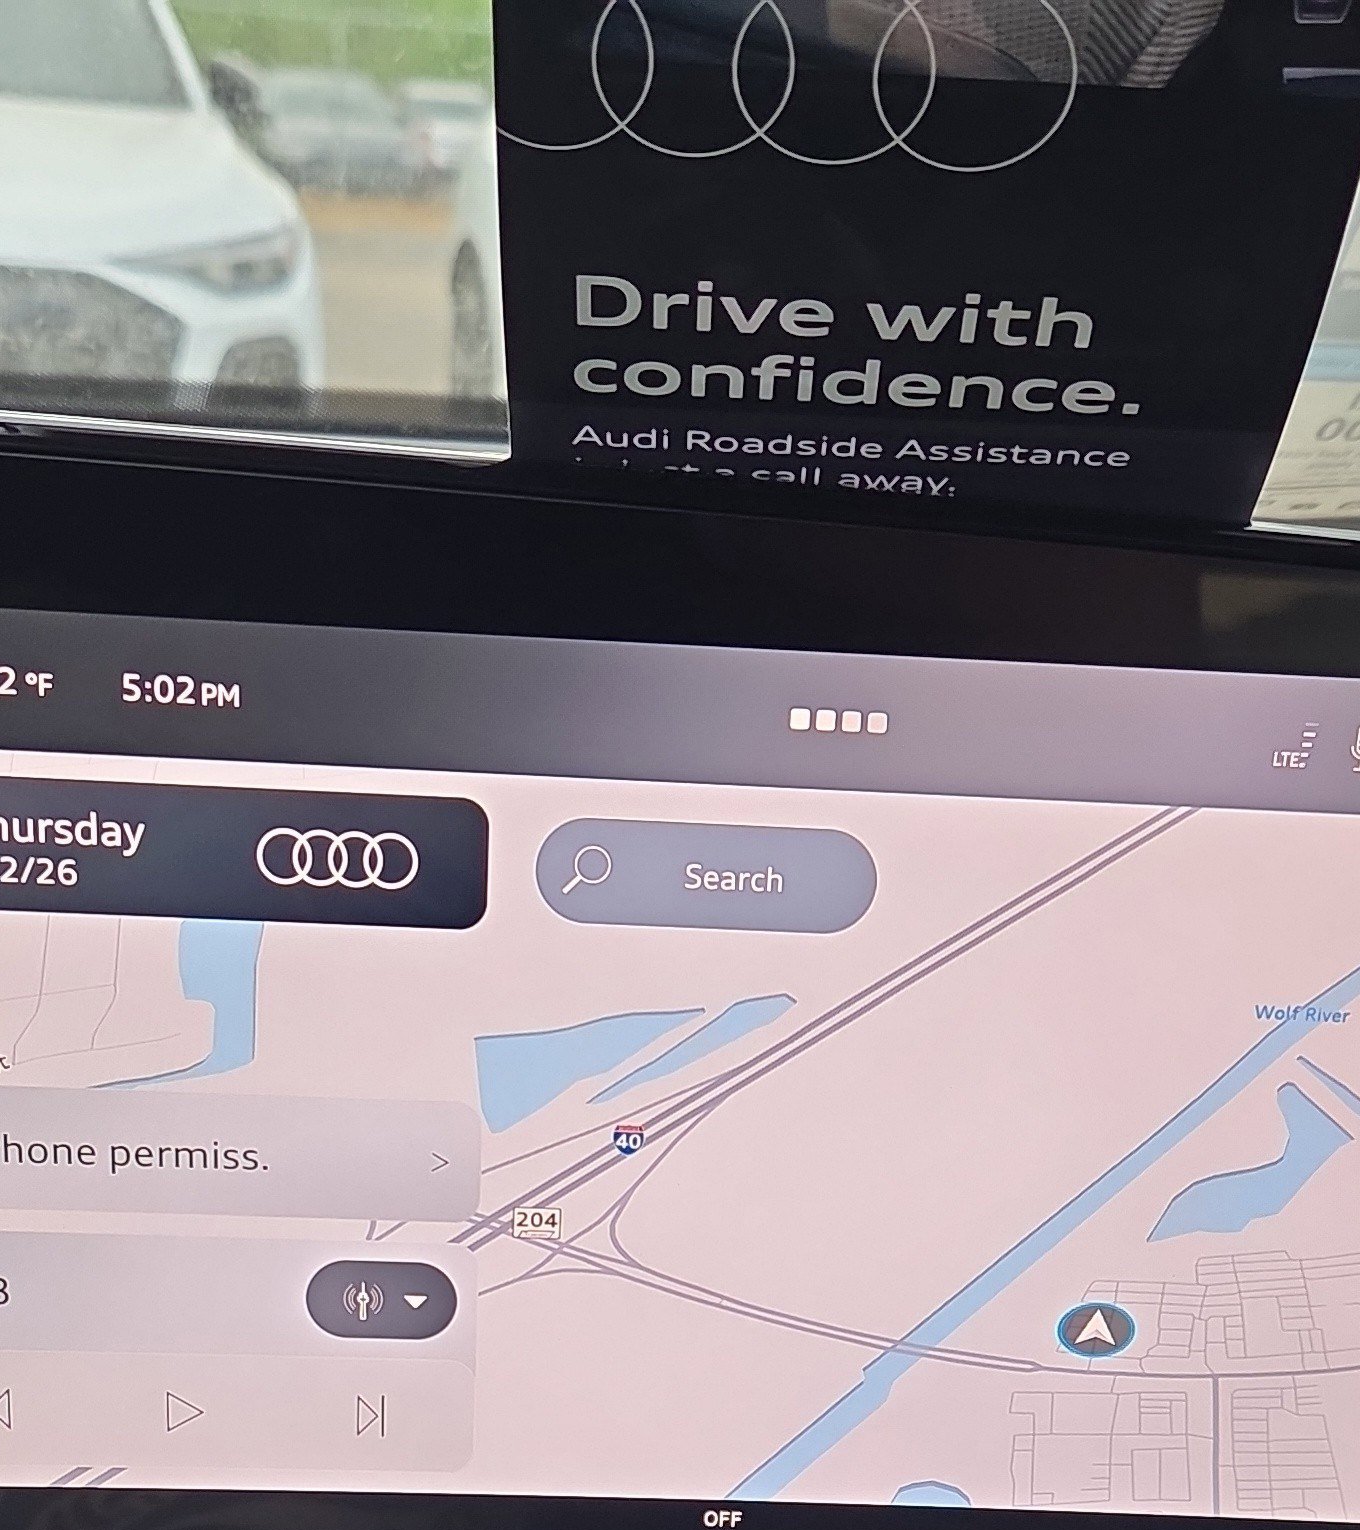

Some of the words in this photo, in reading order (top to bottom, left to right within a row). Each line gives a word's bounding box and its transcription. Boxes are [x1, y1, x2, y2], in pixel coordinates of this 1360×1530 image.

[575, 274, 835, 338] Drive
[865, 292, 1094, 350] with
[573, 354, 1141, 415] confidence.
[571, 424, 670, 451] Audi
[685, 428, 885, 461] Roadside
[894, 438, 1132, 469] Assistance
[1272, 751, 1300, 769] LTE
[684, 862, 784, 894] Search
[1254, 1004, 1303, 1026] Wolf
[1305, 1004, 1351, 1024] River
[615, 1133, 641, 1150] 40
[109, 1140, 270, 1176] permiss.
[516, 1211, 558, 1229] 204
[703, 1510, 744, 1529] OFF
